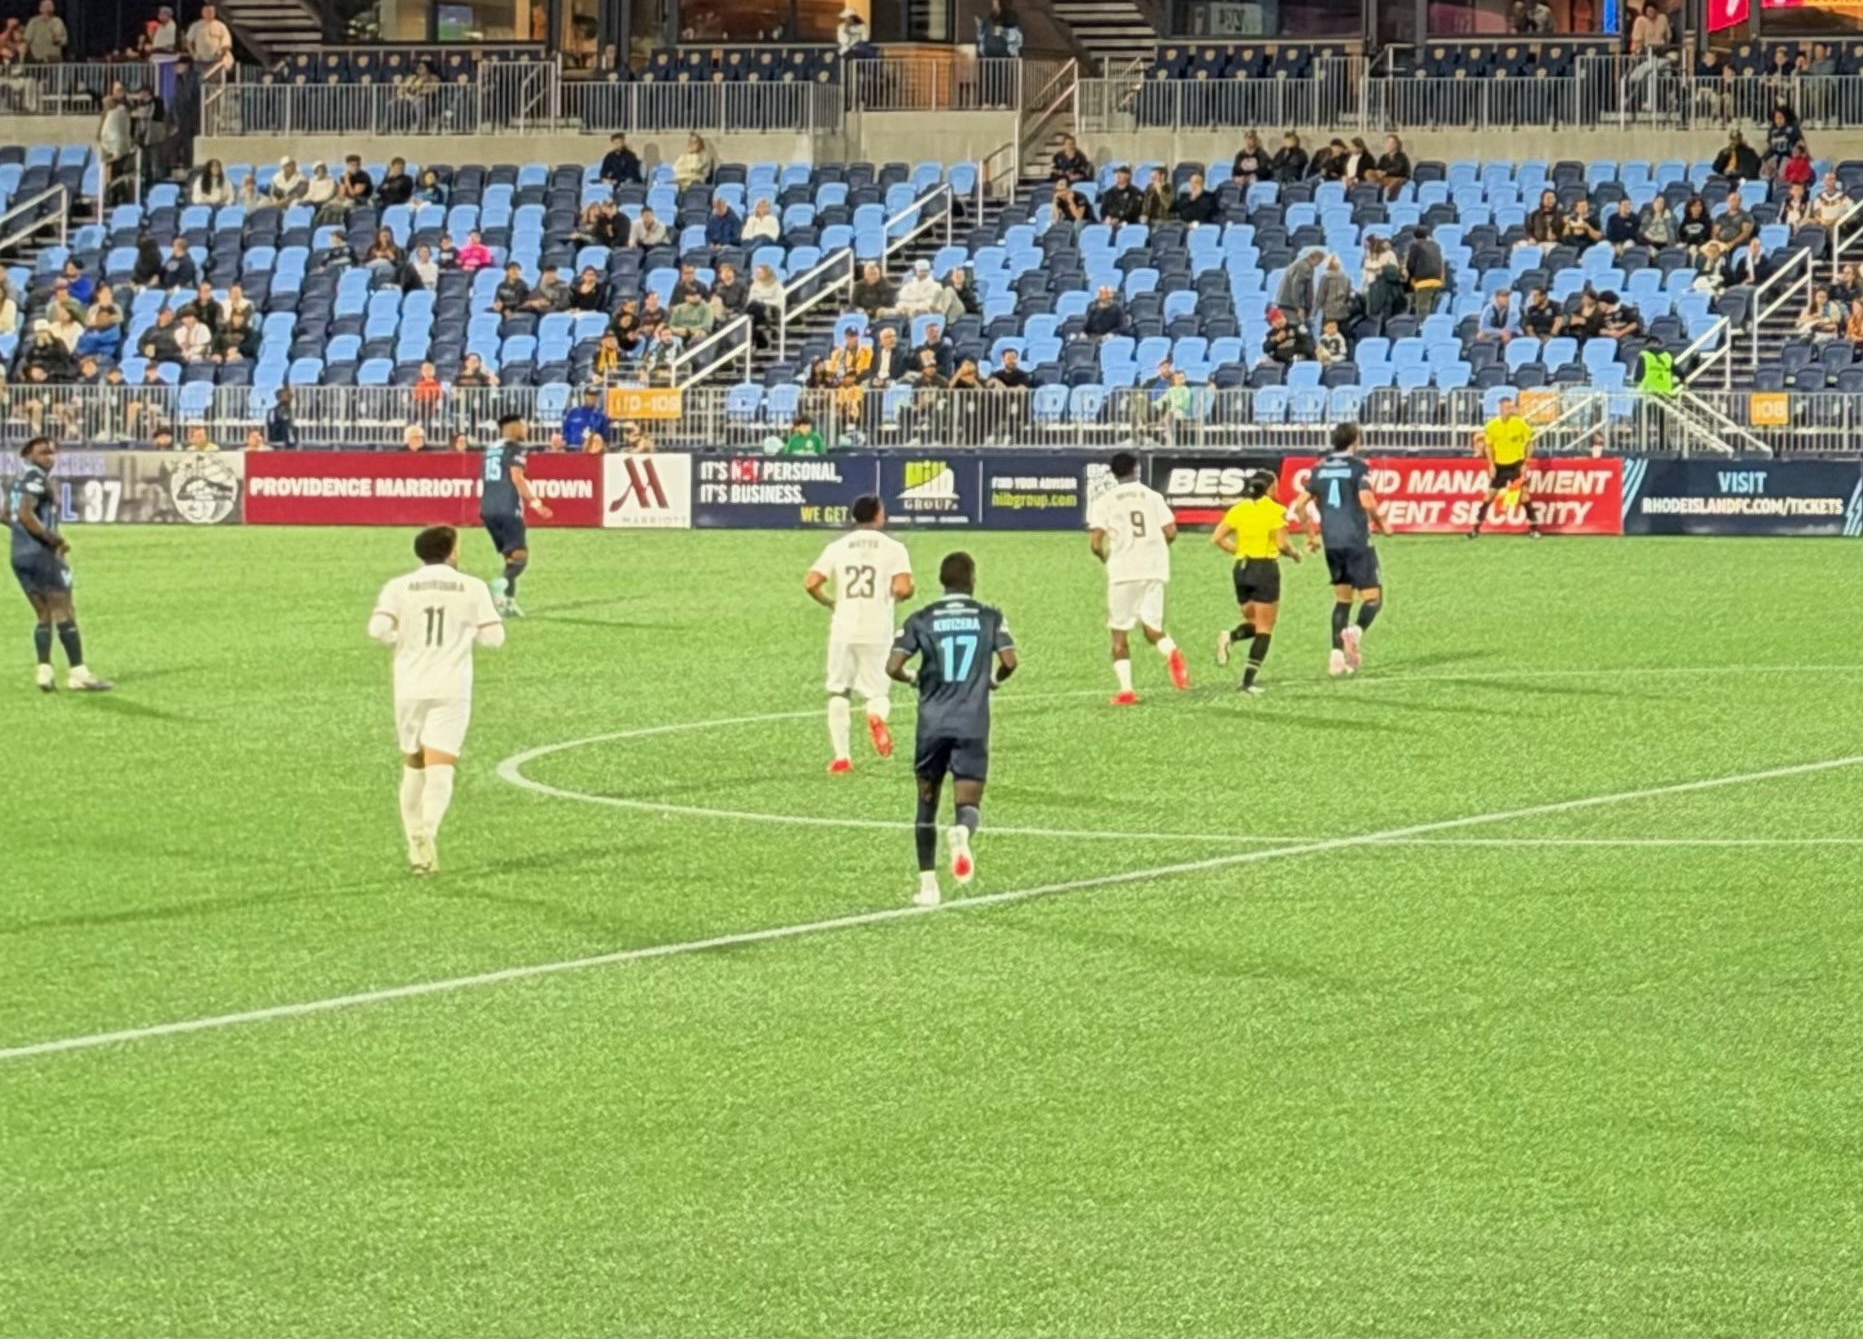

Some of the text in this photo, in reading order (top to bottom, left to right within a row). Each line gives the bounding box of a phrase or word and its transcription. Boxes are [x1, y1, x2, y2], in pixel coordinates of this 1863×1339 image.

[1756, 401, 1788, 417] 108
[700, 462, 728, 480] IT'S
[763, 462, 843, 483] PERSONAL,
[1407, 469, 1614, 496] MANAMENT
[1717, 471, 1767, 493] VISIT
[250, 477, 371, 497] PROVIDENCE
[376, 478, 473, 498] MARRIOTT
[700, 484, 806, 503] IT'S BUSINESS.
[1327, 479, 1340, 508] 4
[84, 480, 121, 522] 37
[1642, 496, 1844, 516] RHODEISLANDFC.COM/TICKETS
[801, 506, 848, 522] WE GET
[1130, 510, 1146, 538] 9
[845, 565, 876, 599] 23
[423, 605, 445, 647] 11
[941, 635, 978, 682] 17
